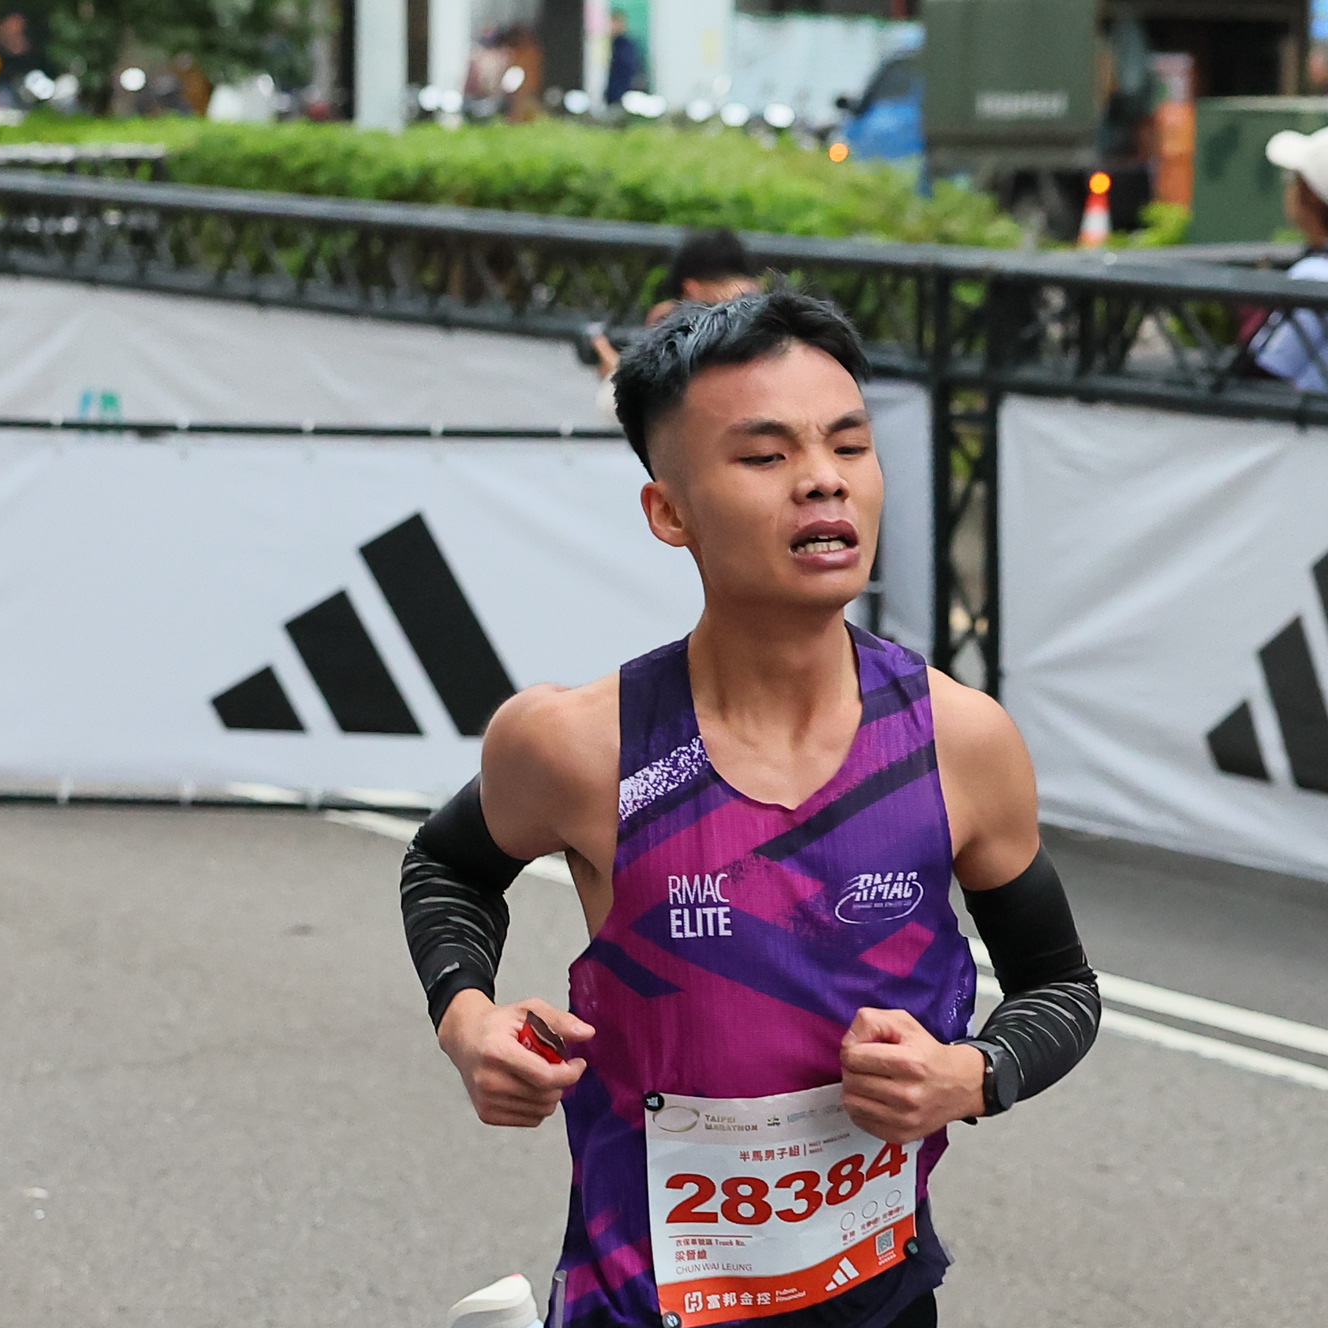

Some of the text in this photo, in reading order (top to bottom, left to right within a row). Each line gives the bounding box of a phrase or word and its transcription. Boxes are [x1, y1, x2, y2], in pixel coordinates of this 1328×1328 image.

[668, 873, 730, 904] RMAC
[670, 906, 733, 939] ELITE
[665, 1142, 909, 1226] 28384
[676, 1262, 753, 1275] CHUN WAI LEUNG
[706, 1291, 772, 1310] 富邦金控
